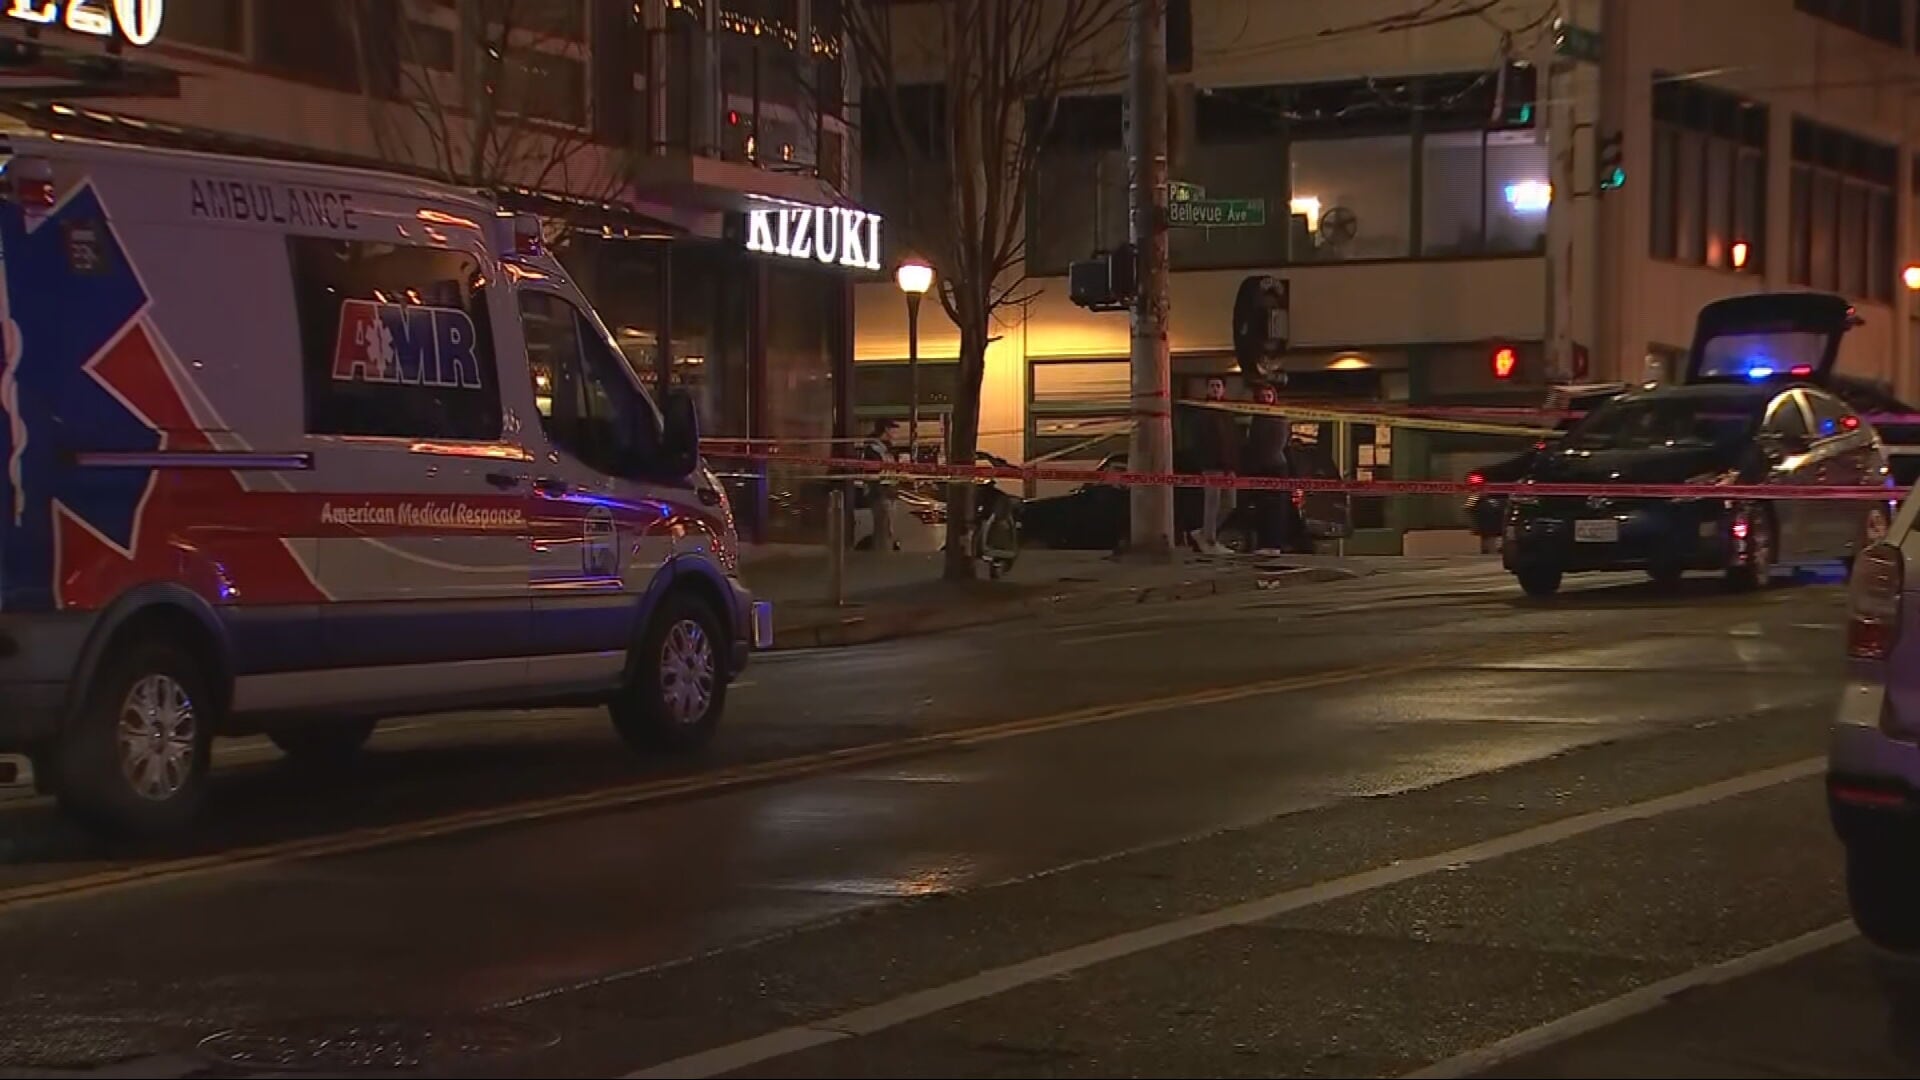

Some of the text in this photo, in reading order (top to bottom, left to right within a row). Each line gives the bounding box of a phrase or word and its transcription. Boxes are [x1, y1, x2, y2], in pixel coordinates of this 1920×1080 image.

[191, 179, 358, 230] AMBULANCE
[1170, 203, 1247, 222] Bellevue Ave
[746, 205, 882, 271] KIZUKI
[332, 298, 482, 389] AMR
[321, 502, 395, 524] American
[399, 502, 453, 526] Medical
